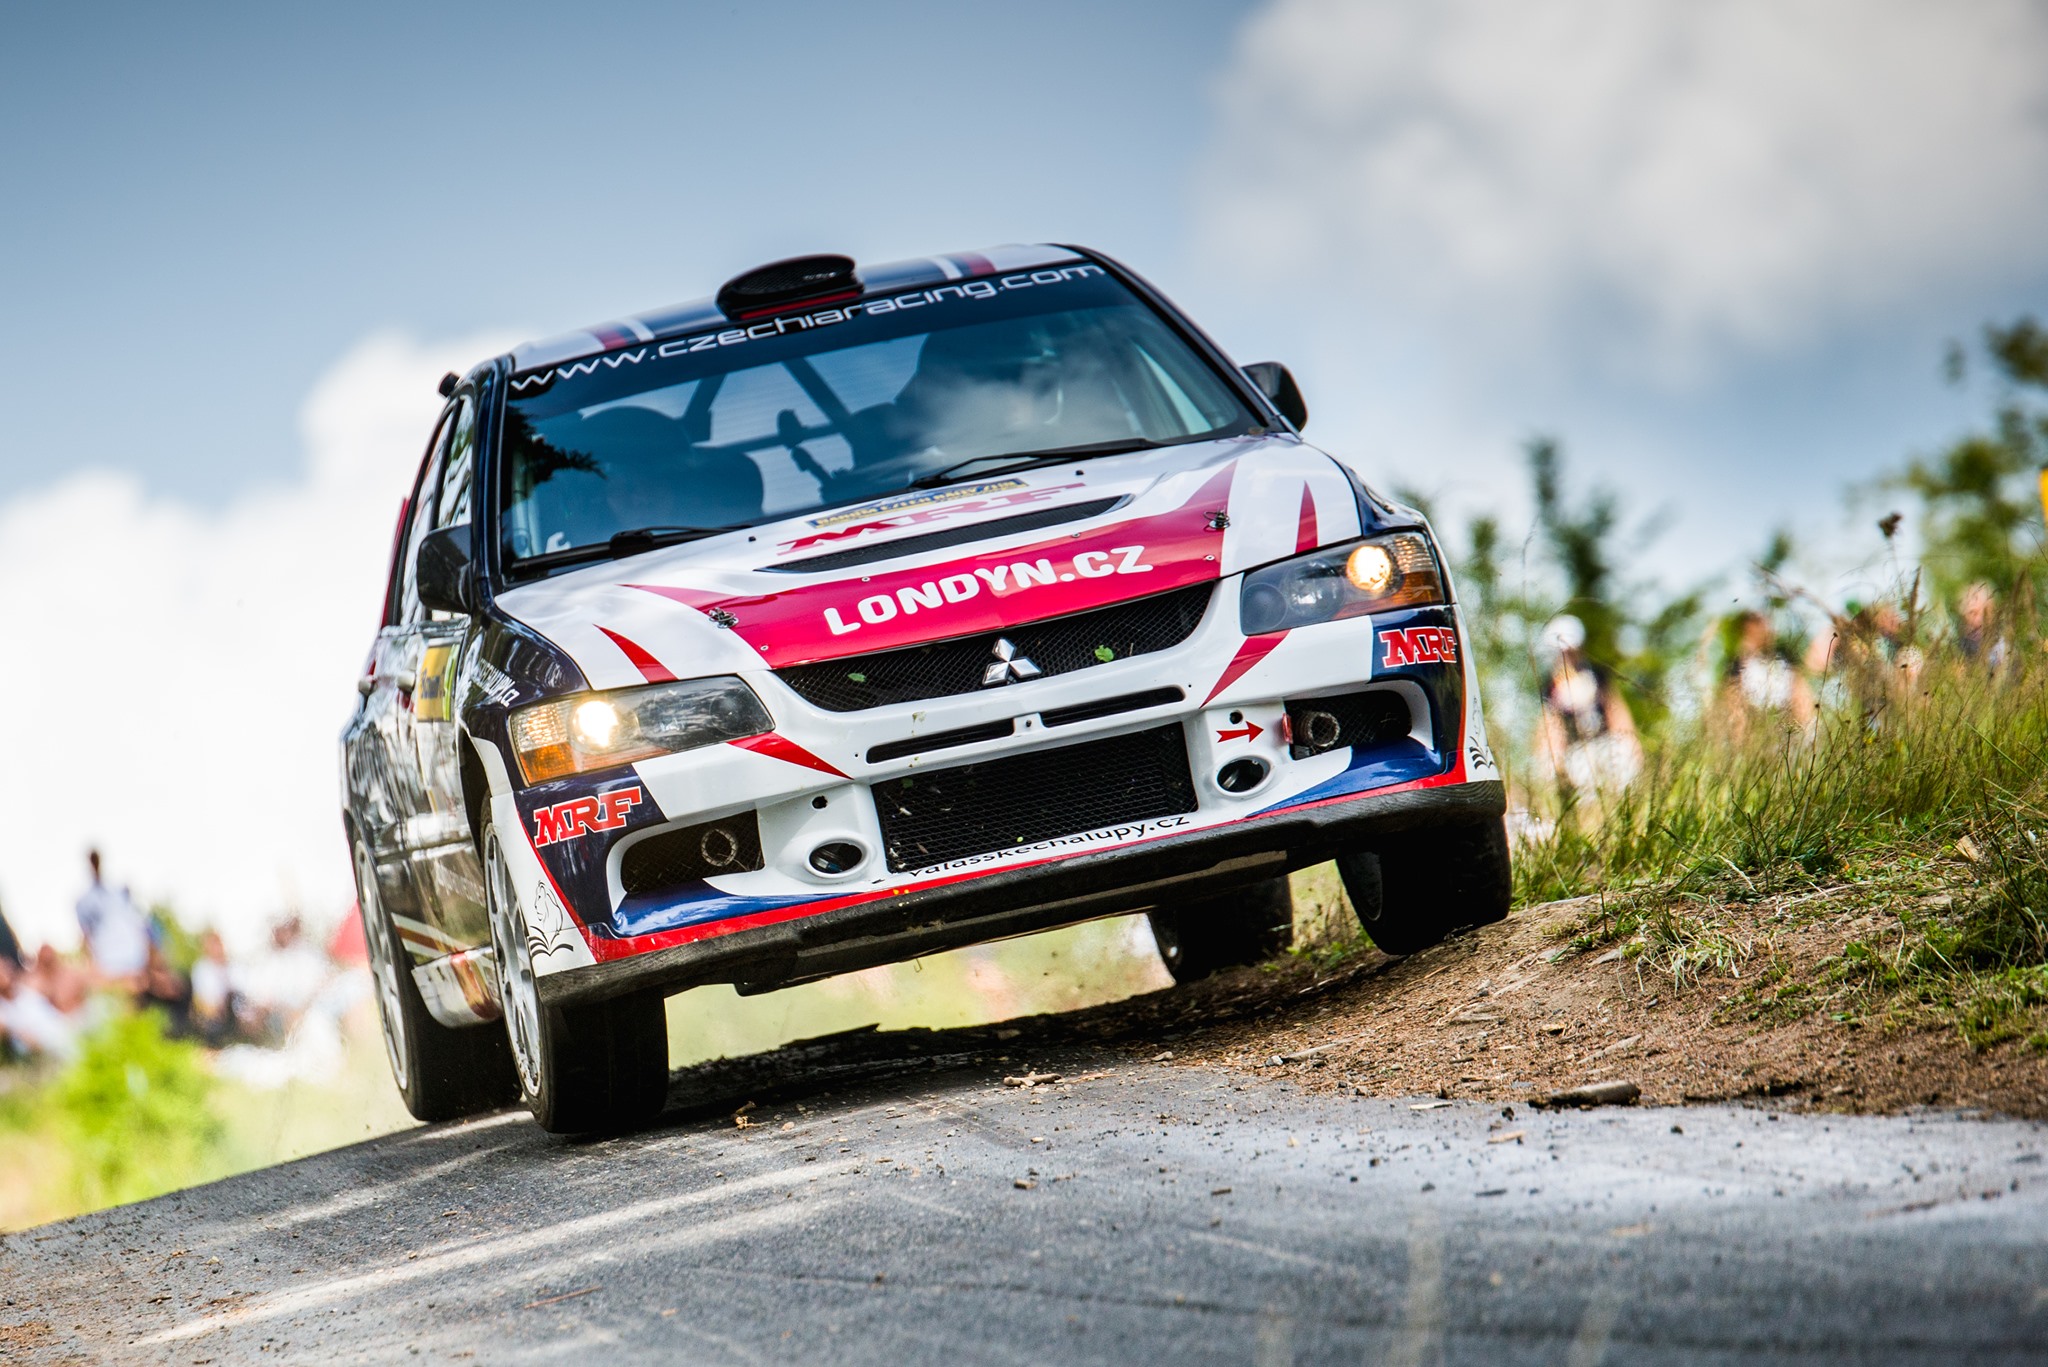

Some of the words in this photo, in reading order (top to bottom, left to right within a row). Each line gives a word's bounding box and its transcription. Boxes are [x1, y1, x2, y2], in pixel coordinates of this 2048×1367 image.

[509, 263, 1106, 391] www.czechiaracing.com
[776, 483, 1087, 556] MRF
[823, 545, 1154, 636] LONDYN.CZ
[1378, 625, 1458, 669] MRF
[533, 786, 643, 849] MRF
[908, 815, 1191, 877] valasskechalupy.cz
